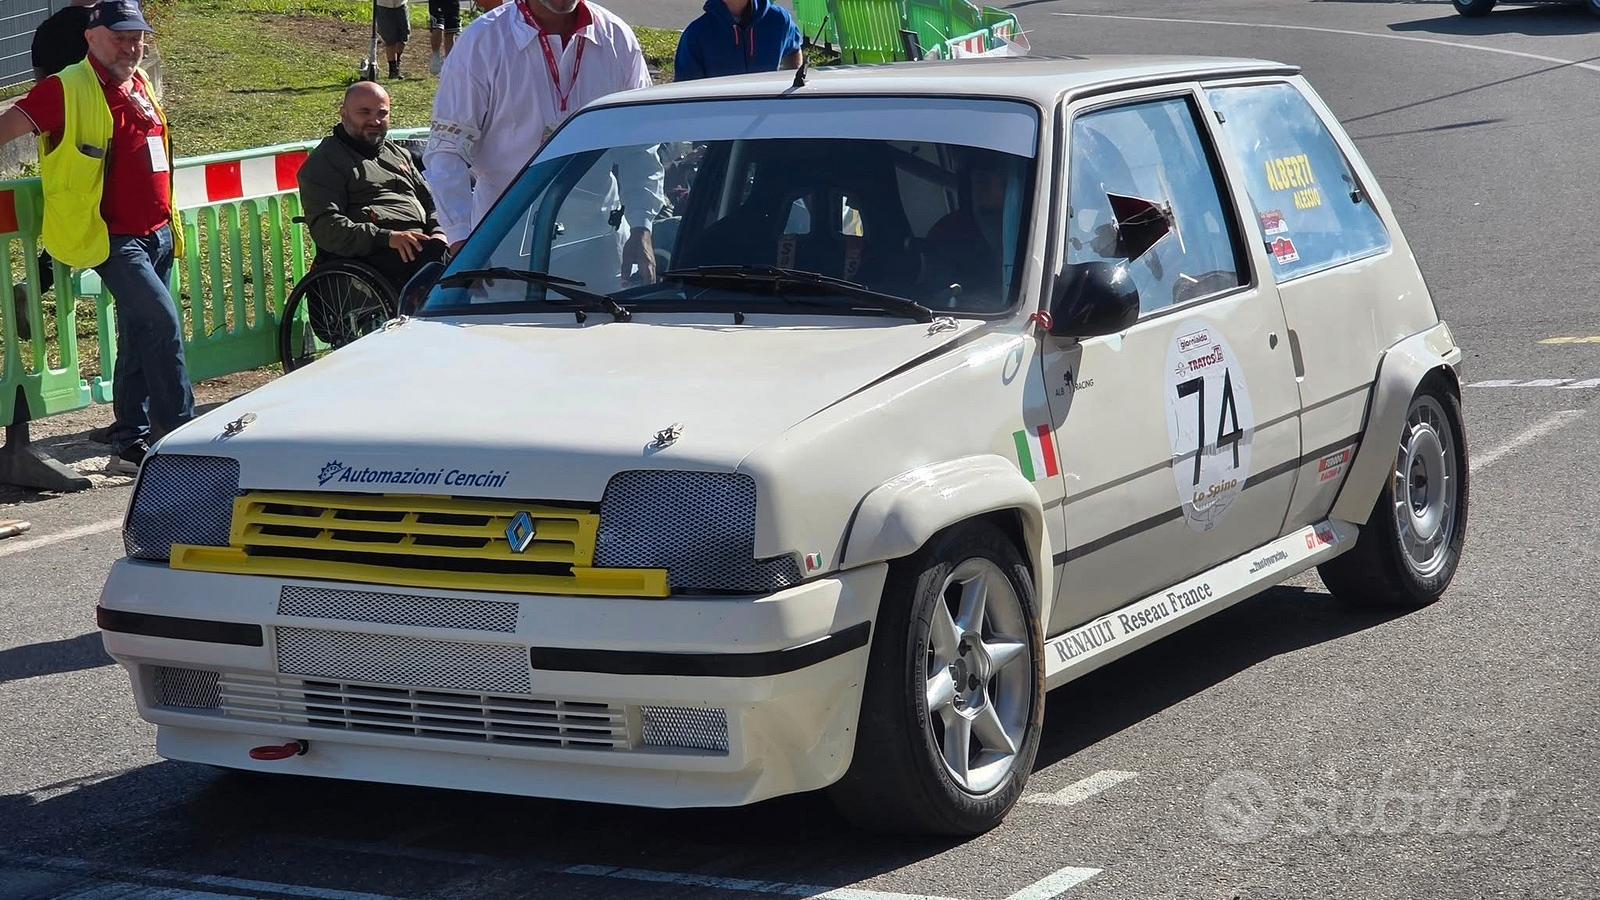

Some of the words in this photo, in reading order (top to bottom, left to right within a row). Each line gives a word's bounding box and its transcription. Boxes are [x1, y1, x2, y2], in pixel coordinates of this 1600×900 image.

[1265, 154, 1314, 192] ALBERTI
[1294, 187, 1321, 209] ALESSIO
[1187, 354, 1216, 371] TRATOS
[1074, 378, 1094, 391] RACING
[1176, 367, 1243, 486] 74
[338, 467, 444, 485] Automazioni
[444, 469, 510, 487] Cencini
[1192, 491, 1205, 503] Lo
[1208, 479, 1237, 498] Spino
[1053, 619, 1116, 663] RENAULT
[1118, 601, 1170, 635] Reseau
[1167, 582, 1213, 613] France
